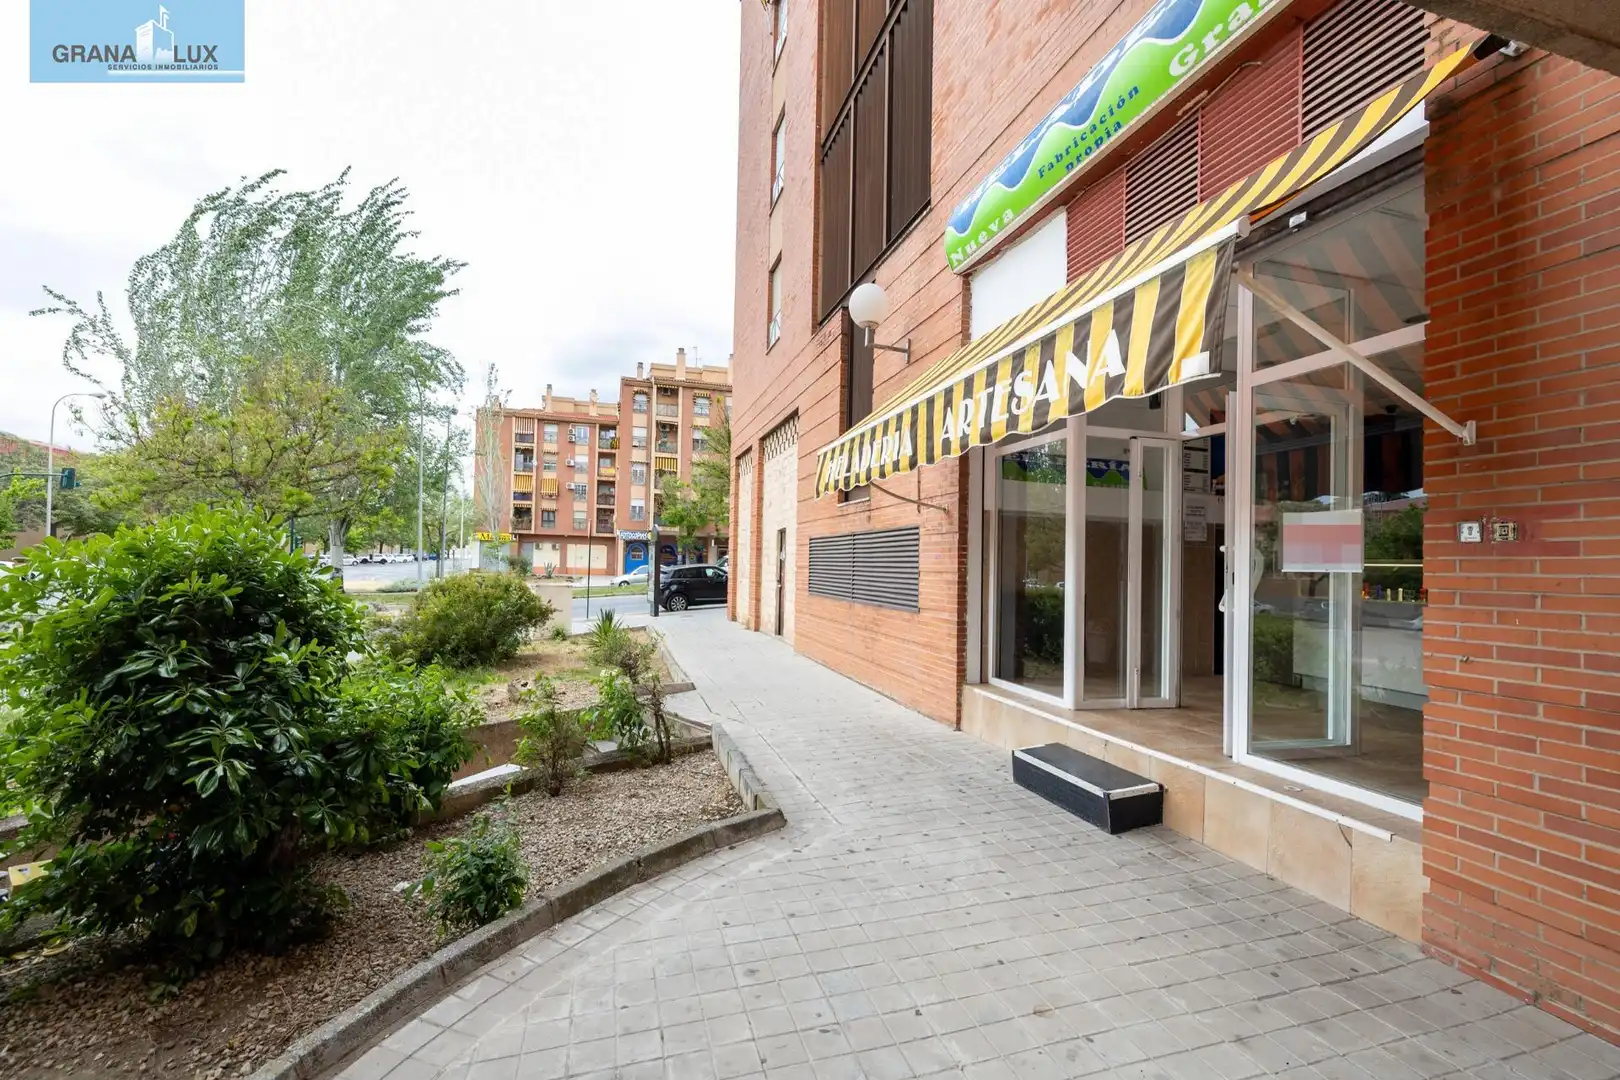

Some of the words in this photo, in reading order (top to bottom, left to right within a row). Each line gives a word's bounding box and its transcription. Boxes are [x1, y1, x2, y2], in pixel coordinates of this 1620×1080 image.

[1168, 0, 1269, 76] Gra
[1037, 86, 1139, 179] Fabricación
[1065, 121, 1122, 172] propia
[949, 208, 1014, 267] Nueva
[940, 328, 1126, 442] ARTESANA
